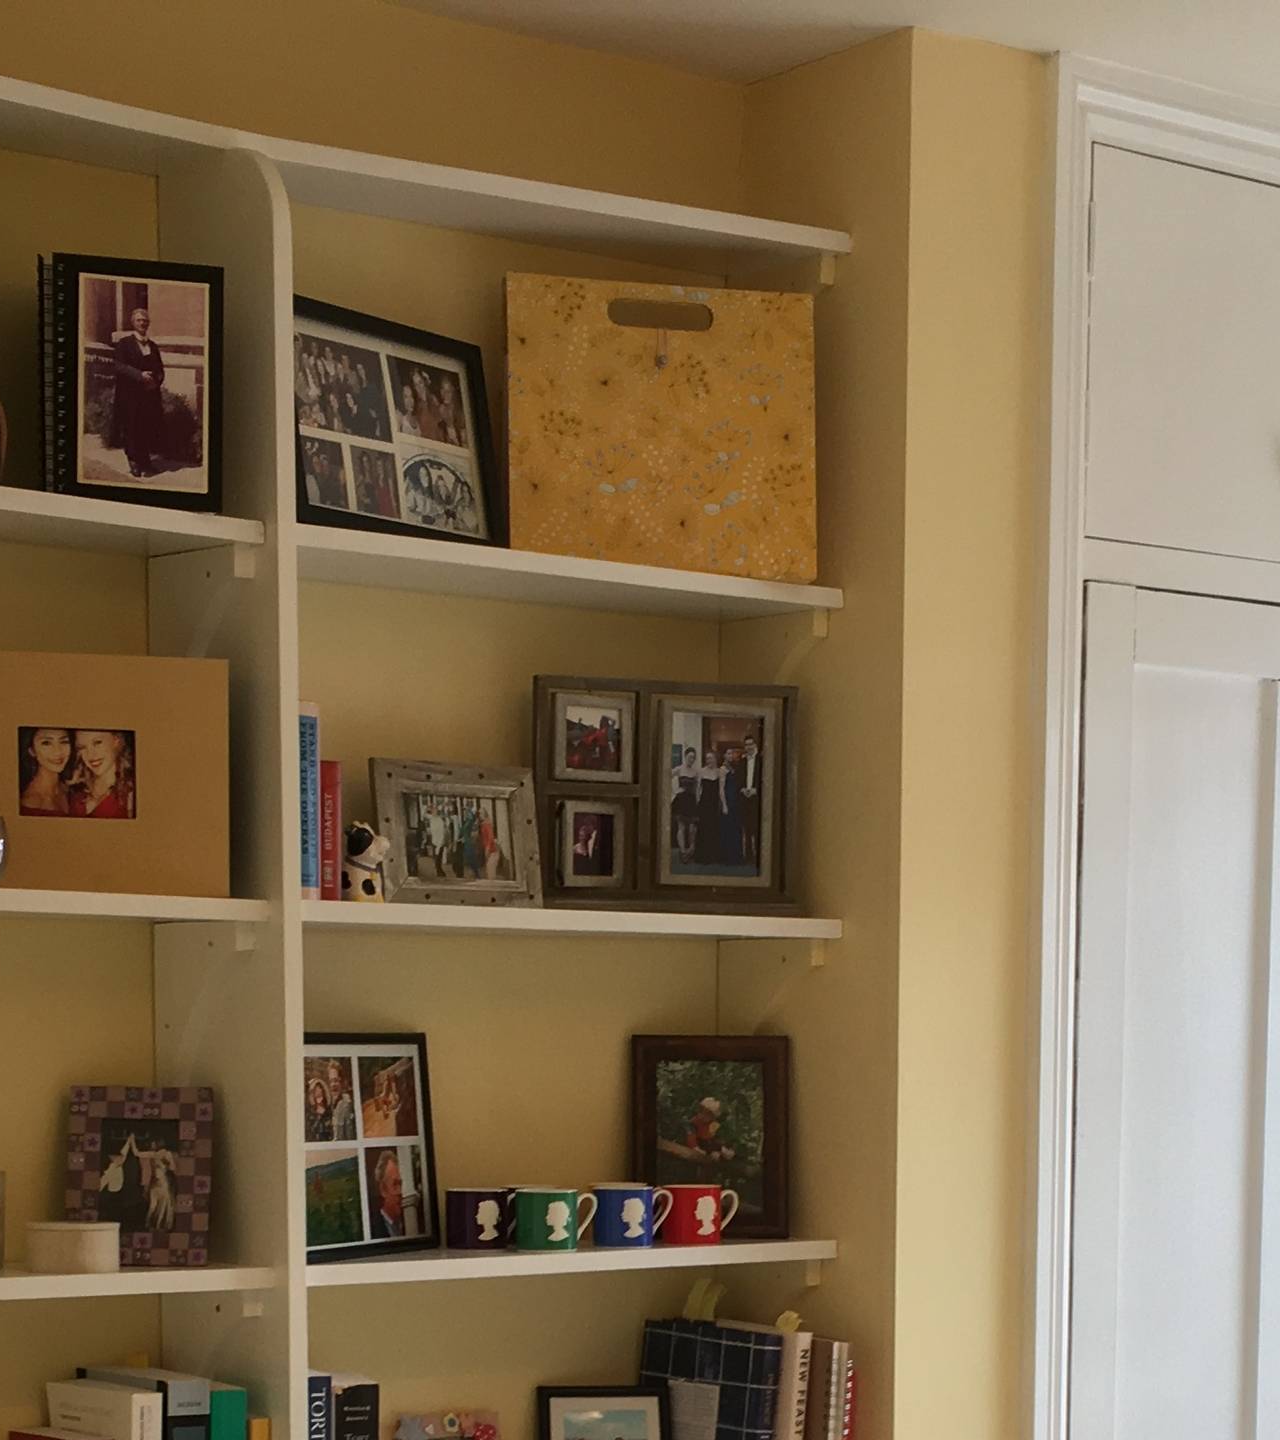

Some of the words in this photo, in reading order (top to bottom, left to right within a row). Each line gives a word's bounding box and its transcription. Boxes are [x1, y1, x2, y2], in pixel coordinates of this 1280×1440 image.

[324, 793, 334, 851] BUDAPEST
[798, 1348, 810, 1383] NEW
[794, 1389, 805, 1437] FEAST
